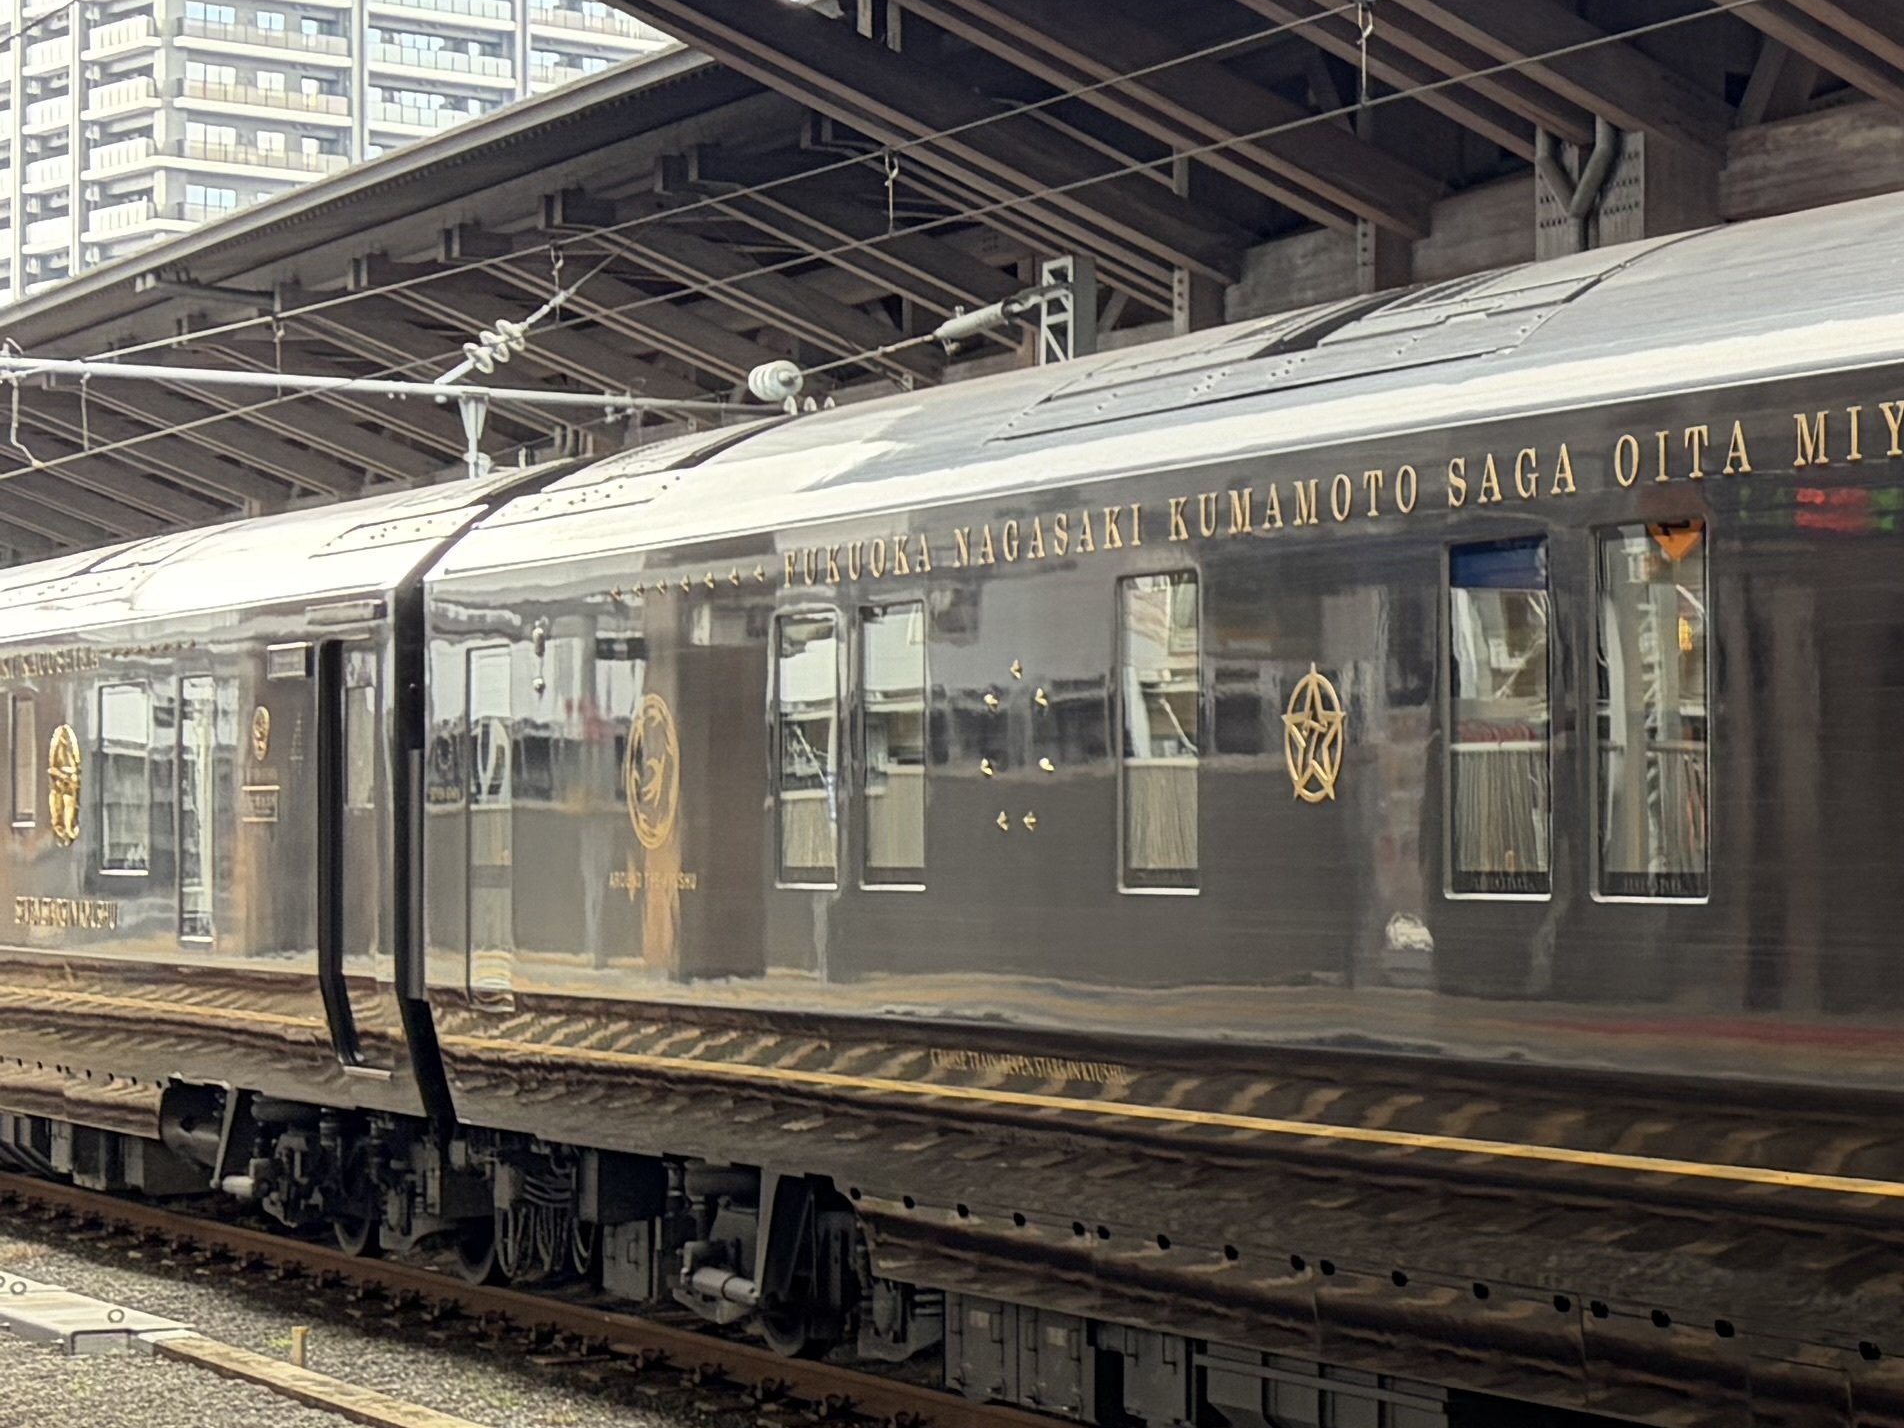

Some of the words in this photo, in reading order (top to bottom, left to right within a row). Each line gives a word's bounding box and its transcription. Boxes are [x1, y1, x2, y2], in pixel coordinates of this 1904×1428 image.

[783, 532, 932, 589] FUKUOKA
[951, 503, 1143, 568] NAGASAKI
[1168, 464, 1418, 541] KUMAMOTO
[1447, 443, 1577, 507] SAGA
[1614, 419, 1752, 487] OITA
